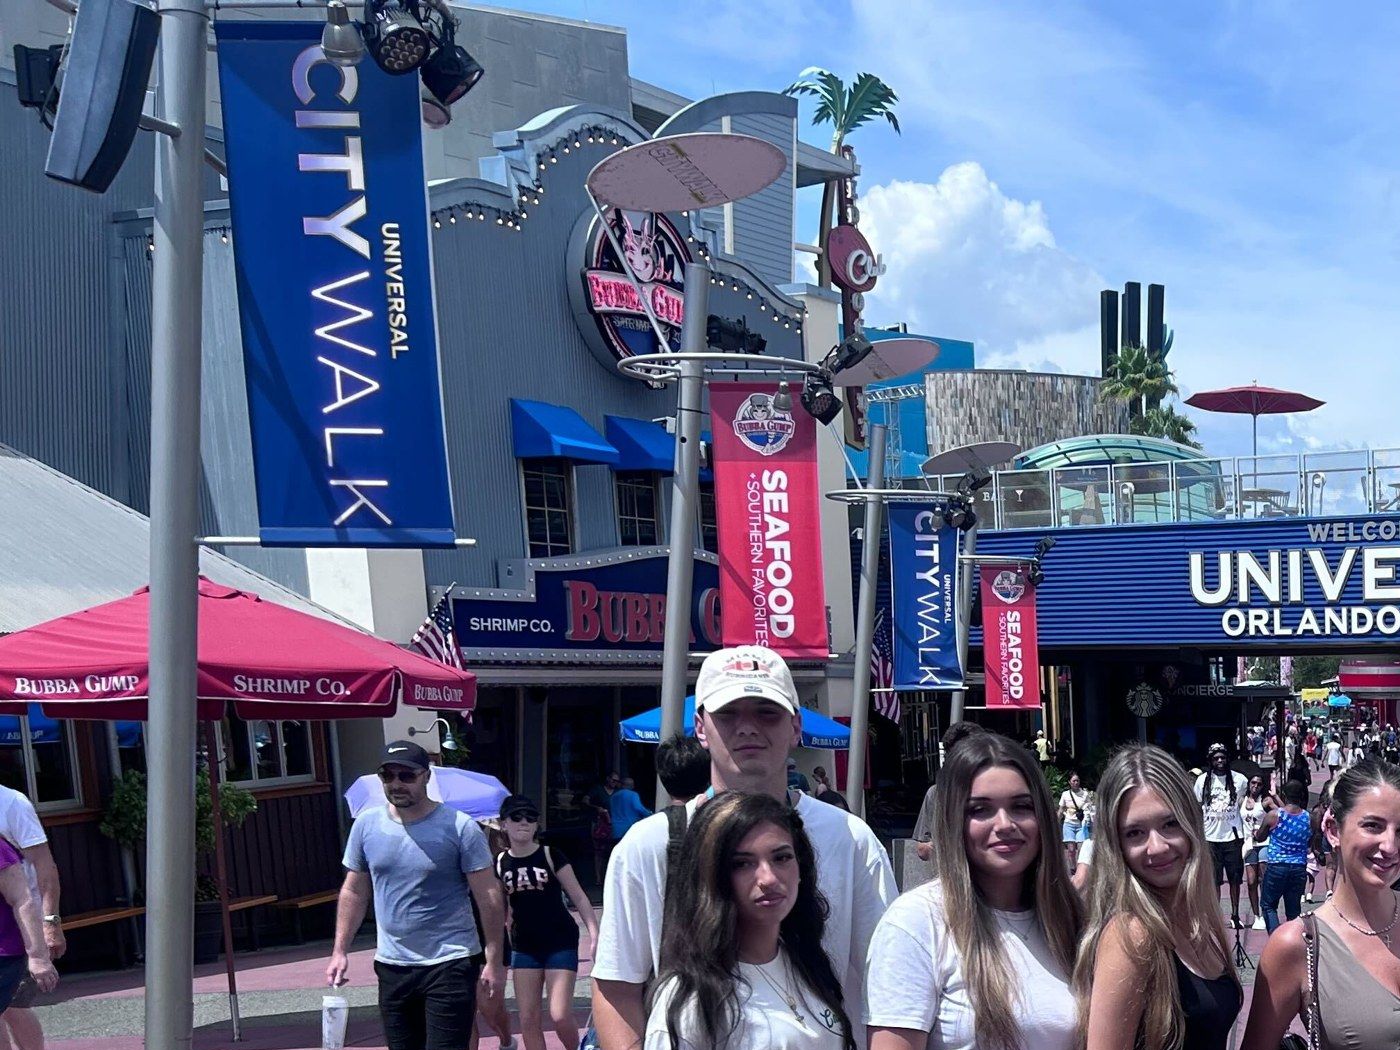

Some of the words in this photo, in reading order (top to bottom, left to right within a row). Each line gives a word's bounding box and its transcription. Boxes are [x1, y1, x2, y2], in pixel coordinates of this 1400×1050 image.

[291, 43, 394, 526] CITYWALK
[381, 222, 410, 360] UNIVERSAL
[767, 420, 792, 433] GUMP
[762, 469, 795, 639] SEAFOOD
[563, 580, 696, 643] BUBB
[751, 568, 769, 647] FAVORITES
[914, 510, 942, 685] CITYWALK
[943, 574, 952, 624] UNIVERSAL
[470, 617, 528, 632] SHRIMP
[530, 619, 555, 633] CO.
[1006, 610, 1024, 700] SEAFOOD
[14, 677, 80, 695] BUBBA
[84, 674, 139, 693] GUMP
[234, 674, 310, 695] SHRIMP
[316, 678, 351, 696] CO.
[414, 684, 441, 701] BUBBA
[443, 685, 464, 703] GUMP
[1000, 661, 1010, 705] FAVORITES
[811, 736, 832, 746] BUBBA
[502, 866, 549, 895] GAP
